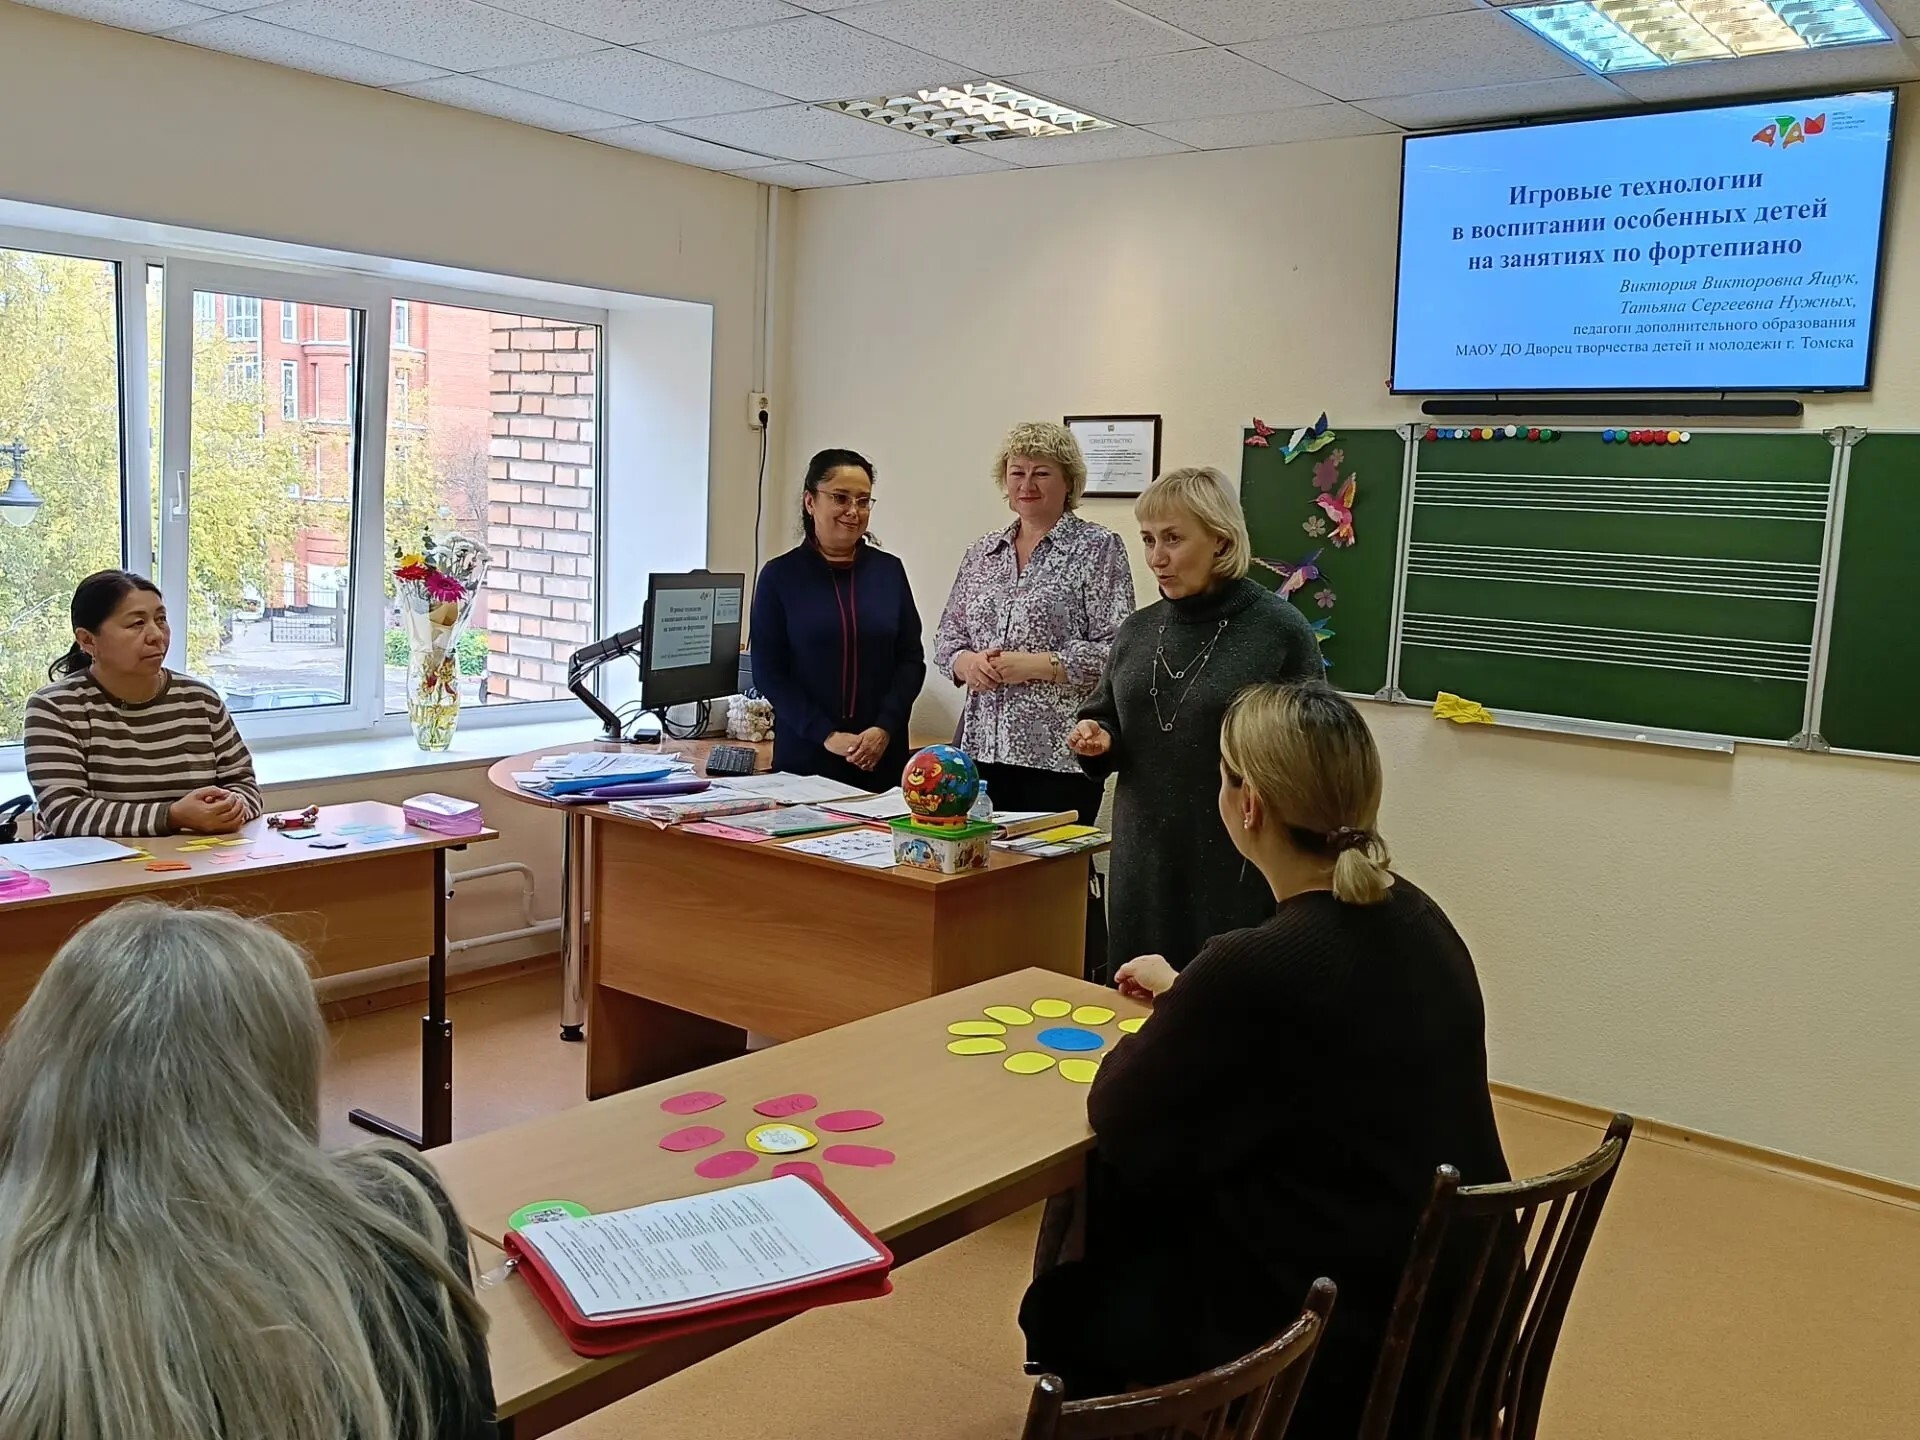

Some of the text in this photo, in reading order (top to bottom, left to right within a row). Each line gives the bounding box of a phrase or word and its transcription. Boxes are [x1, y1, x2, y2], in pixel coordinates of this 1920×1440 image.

[1508, 173, 1763, 208] Игровые технологии
[1452, 197, 1828, 241] в воспитании особенных детей
[1468, 236, 1802, 270] на занятиях по фортепиано
[1619, 271, 1859, 295] Виктория Викторовна Ящук,
[1620, 294, 1857, 316] Татьяна Сергеевна Нужных,
[1573, 317, 1857, 336] педагоги дополнительного образования
[1456, 335, 1854, 357] МАОУ ДО Дворец творчества детей и молодежи г. Томска
